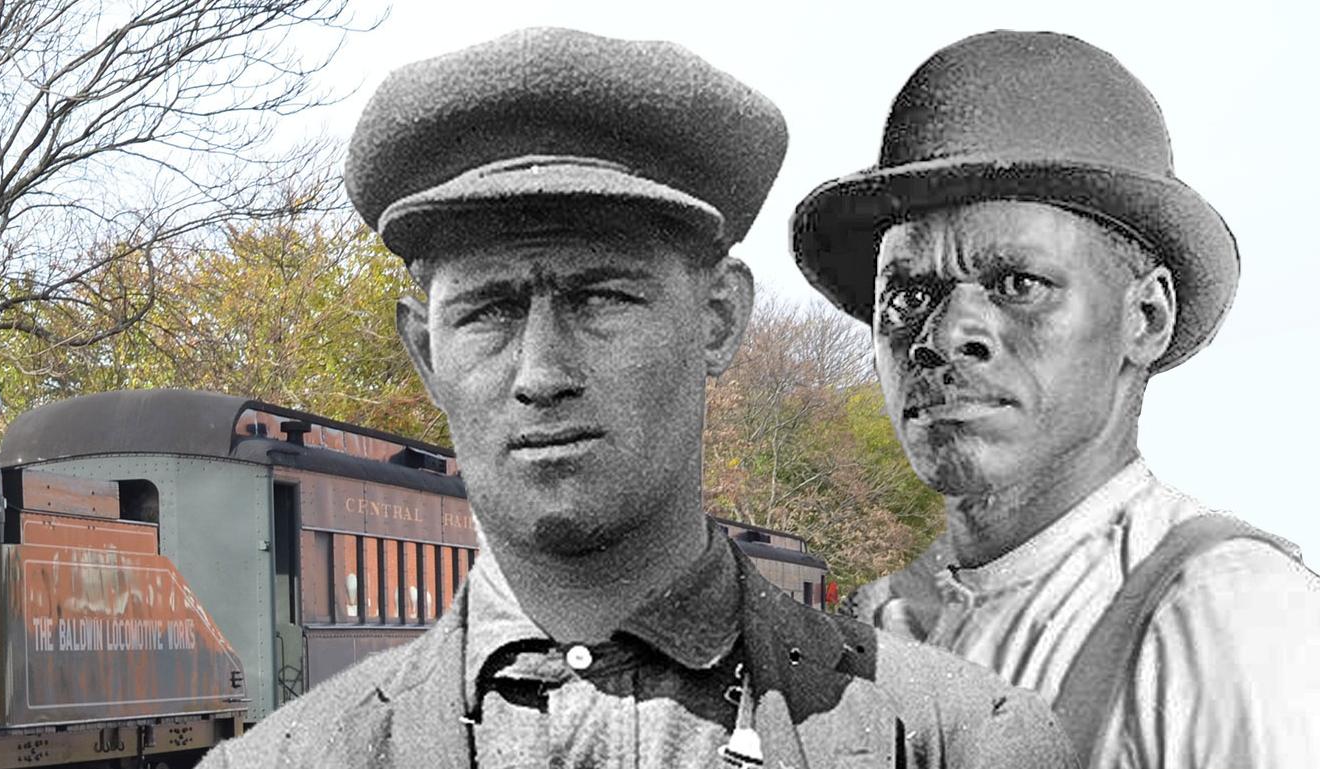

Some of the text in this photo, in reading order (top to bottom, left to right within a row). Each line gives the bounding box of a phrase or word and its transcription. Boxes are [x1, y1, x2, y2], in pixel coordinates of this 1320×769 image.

[345, 497, 423, 522] CENTRAL
[33, 617, 196, 651] THE BALDWIN LOCOMOTIVE WORKS
